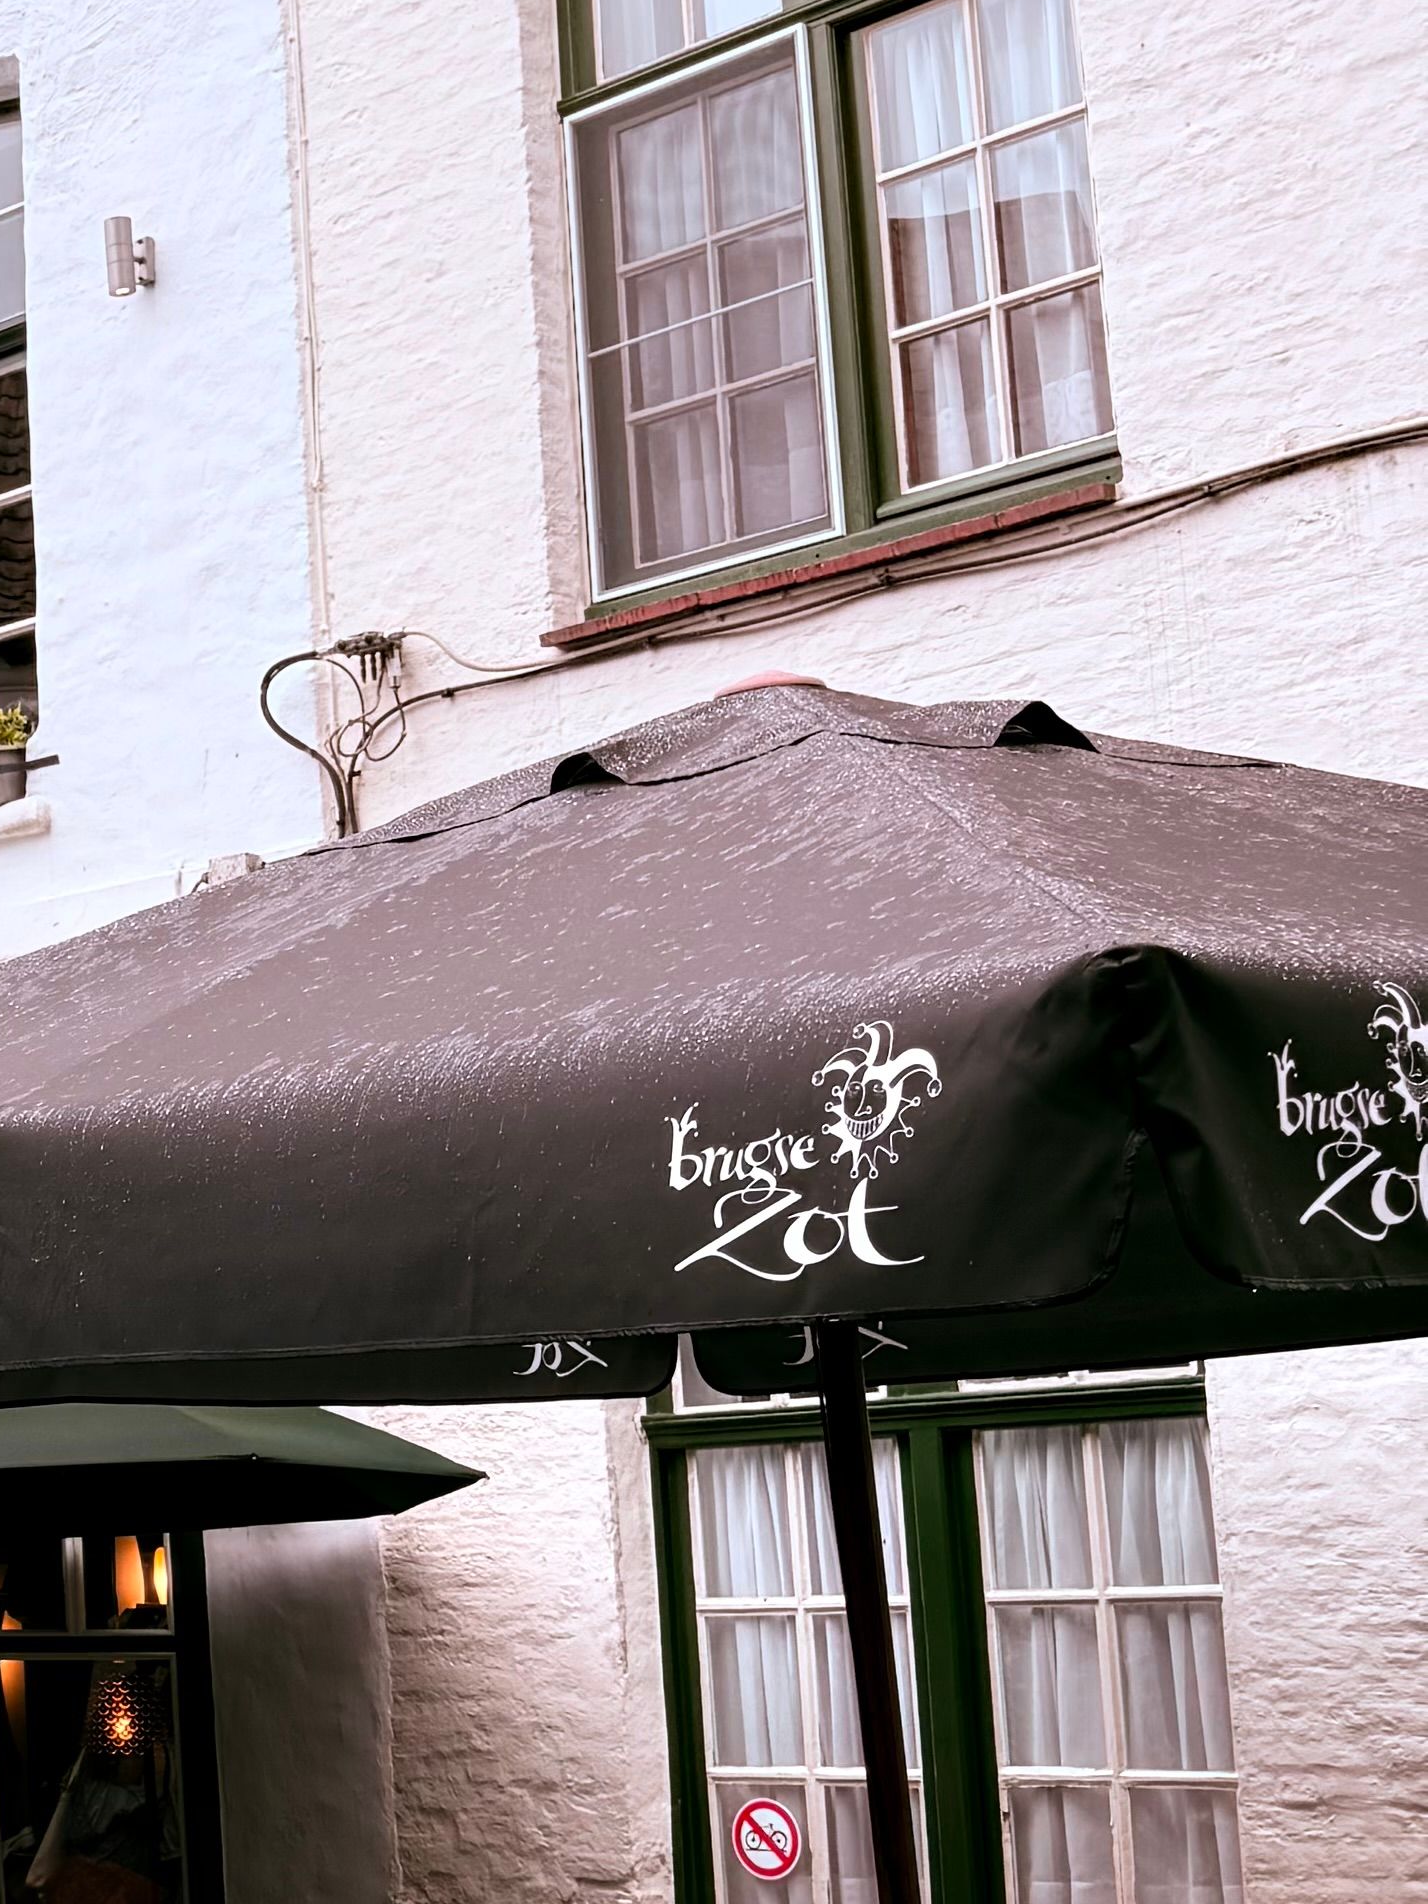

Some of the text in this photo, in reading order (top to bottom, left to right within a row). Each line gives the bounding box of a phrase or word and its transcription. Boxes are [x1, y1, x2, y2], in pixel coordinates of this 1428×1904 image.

[1267, 1039, 1392, 1158] brugse
[664, 1102, 820, 1204] brugse
[1299, 1142, 1428, 1242] Zo
[674, 1177, 925, 1281] Zot
